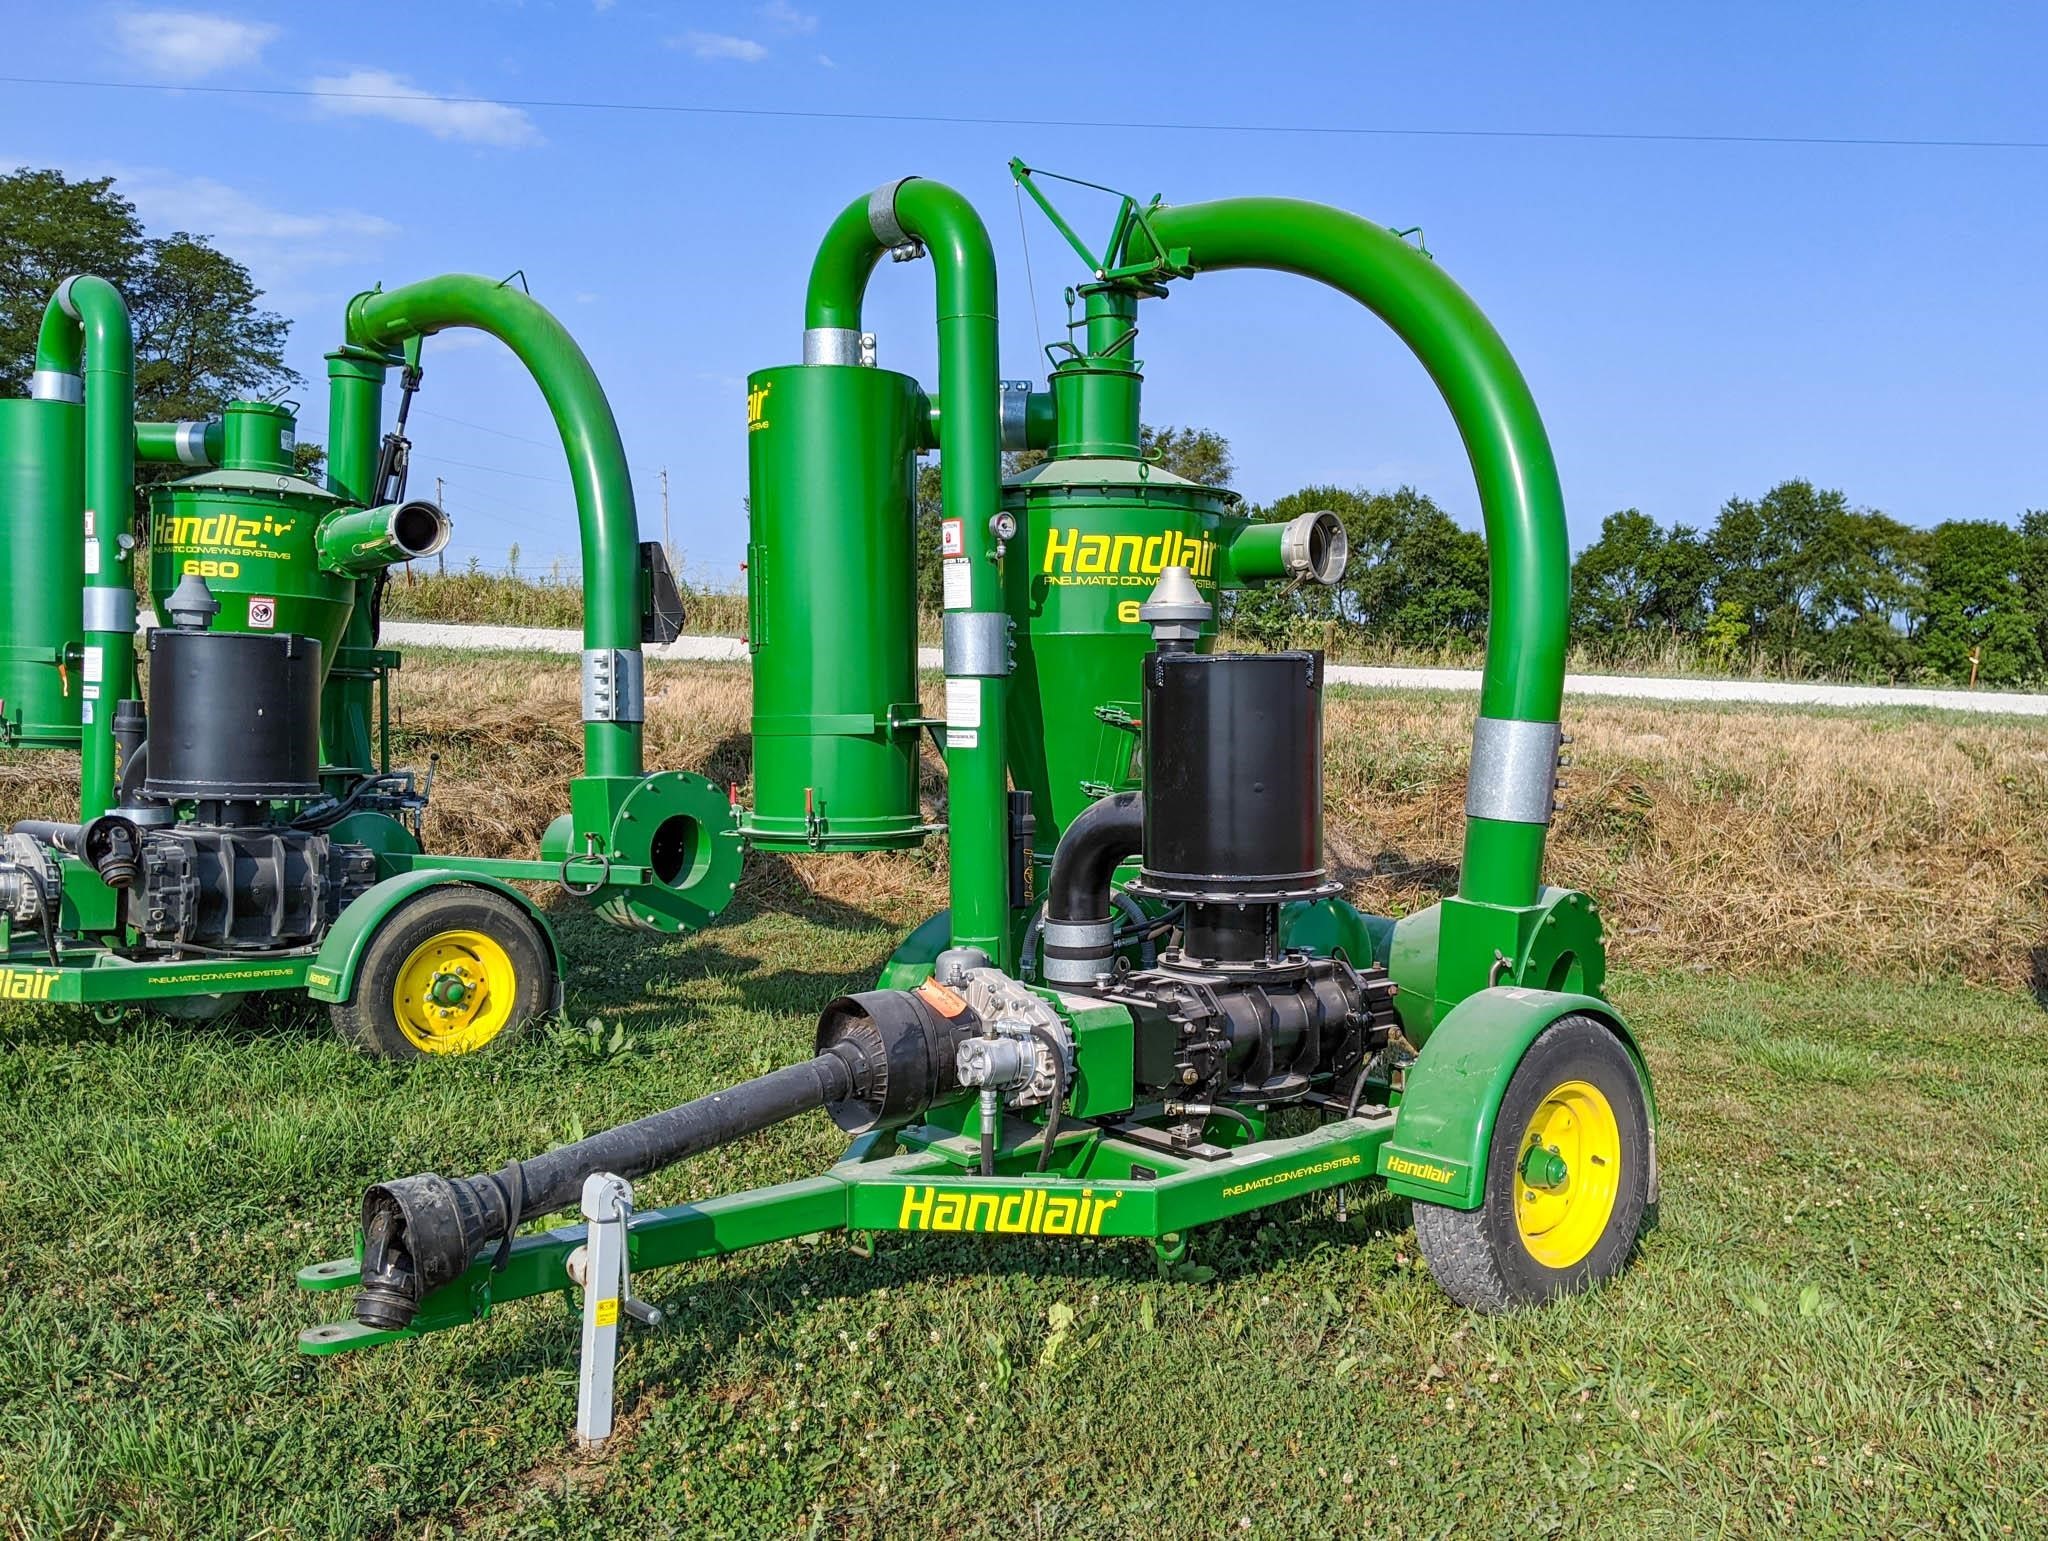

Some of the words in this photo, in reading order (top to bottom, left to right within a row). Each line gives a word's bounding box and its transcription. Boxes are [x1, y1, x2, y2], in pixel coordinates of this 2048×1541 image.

[153, 545, 185, 554] NEUMATIC
[186, 546, 241, 556] CONVEYING
[242, 549, 291, 560] SYSTEMS
[1043, 528, 1216, 577] Handlair
[183, 560, 240, 578] 680
[1044, 575, 1119, 587] PNEUMATIC
[1192, 578, 1217, 590] YSTEMS
[148, 973, 200, 985] PNEUMATIC
[201, 971, 252, 981] CONVEYING
[253, 968, 294, 977] SYSTEMS
[1223, 1177, 1273, 1198] PNEUMATIC
[1273, 1164, 1322, 1184] CONVEYING
[1322, 1154, 1361, 1172] SYSTEMS
[1387, 1155, 1456, 1184] Handlair
[899, 1186, 1119, 1236] Handlair
